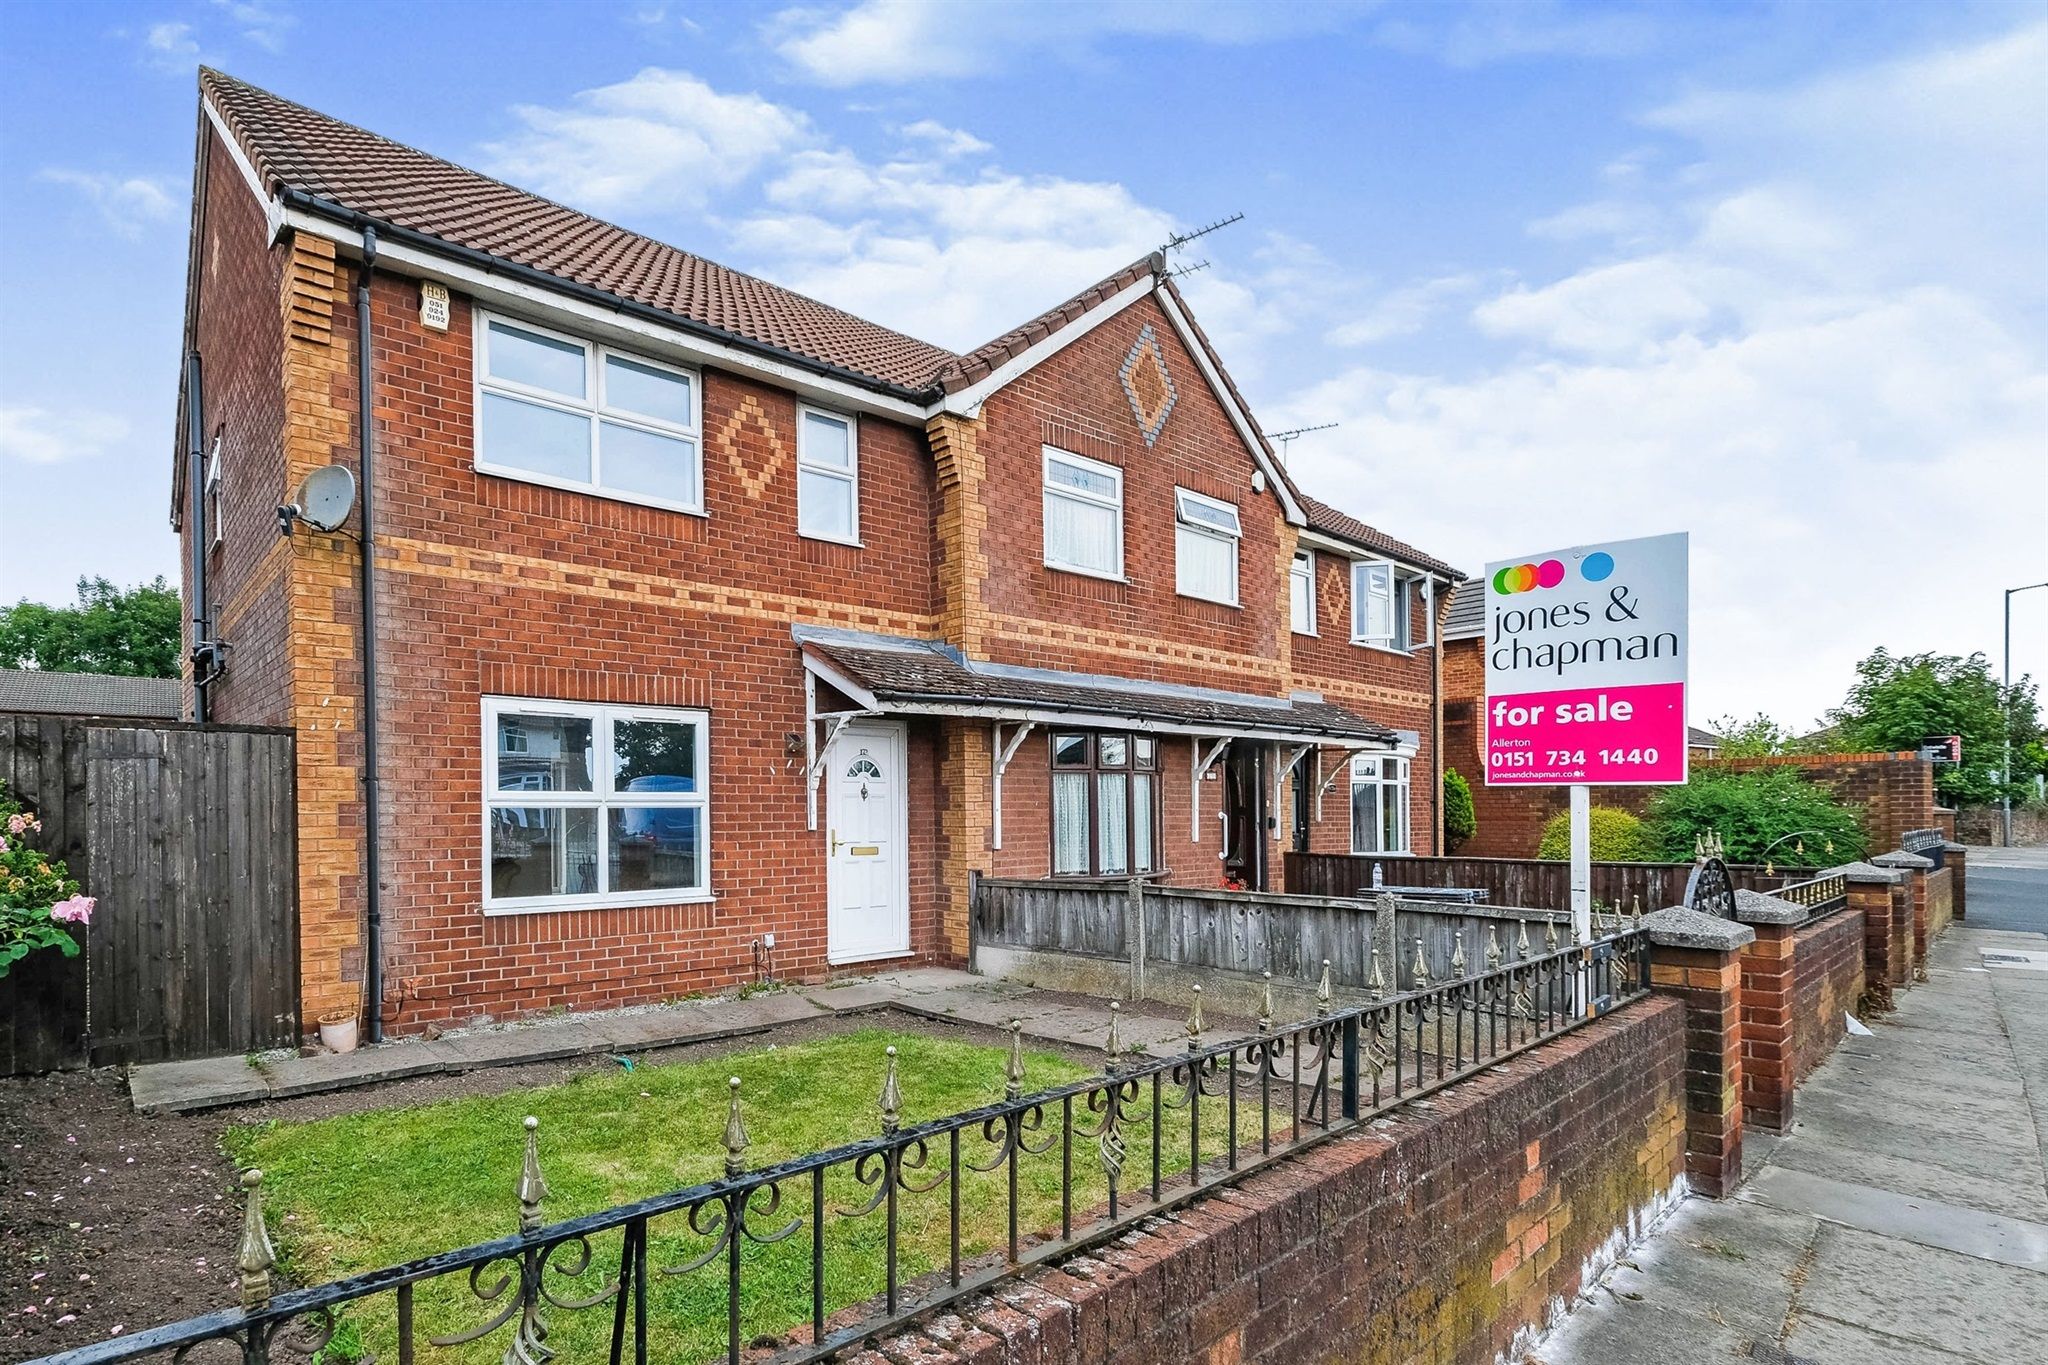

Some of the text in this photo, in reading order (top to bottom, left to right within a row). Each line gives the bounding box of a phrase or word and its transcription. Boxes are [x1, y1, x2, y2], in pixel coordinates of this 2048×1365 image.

[1493, 585, 1640, 645] jones &
[1492, 632, 1678, 675] chapman
[1492, 694, 1634, 727] for sale
[1492, 738, 1531, 748] Allerton
[1491, 748, 1659, 767] 0151 734 1440
[1492, 769, 1586, 780] jonesandchapman.co.k
